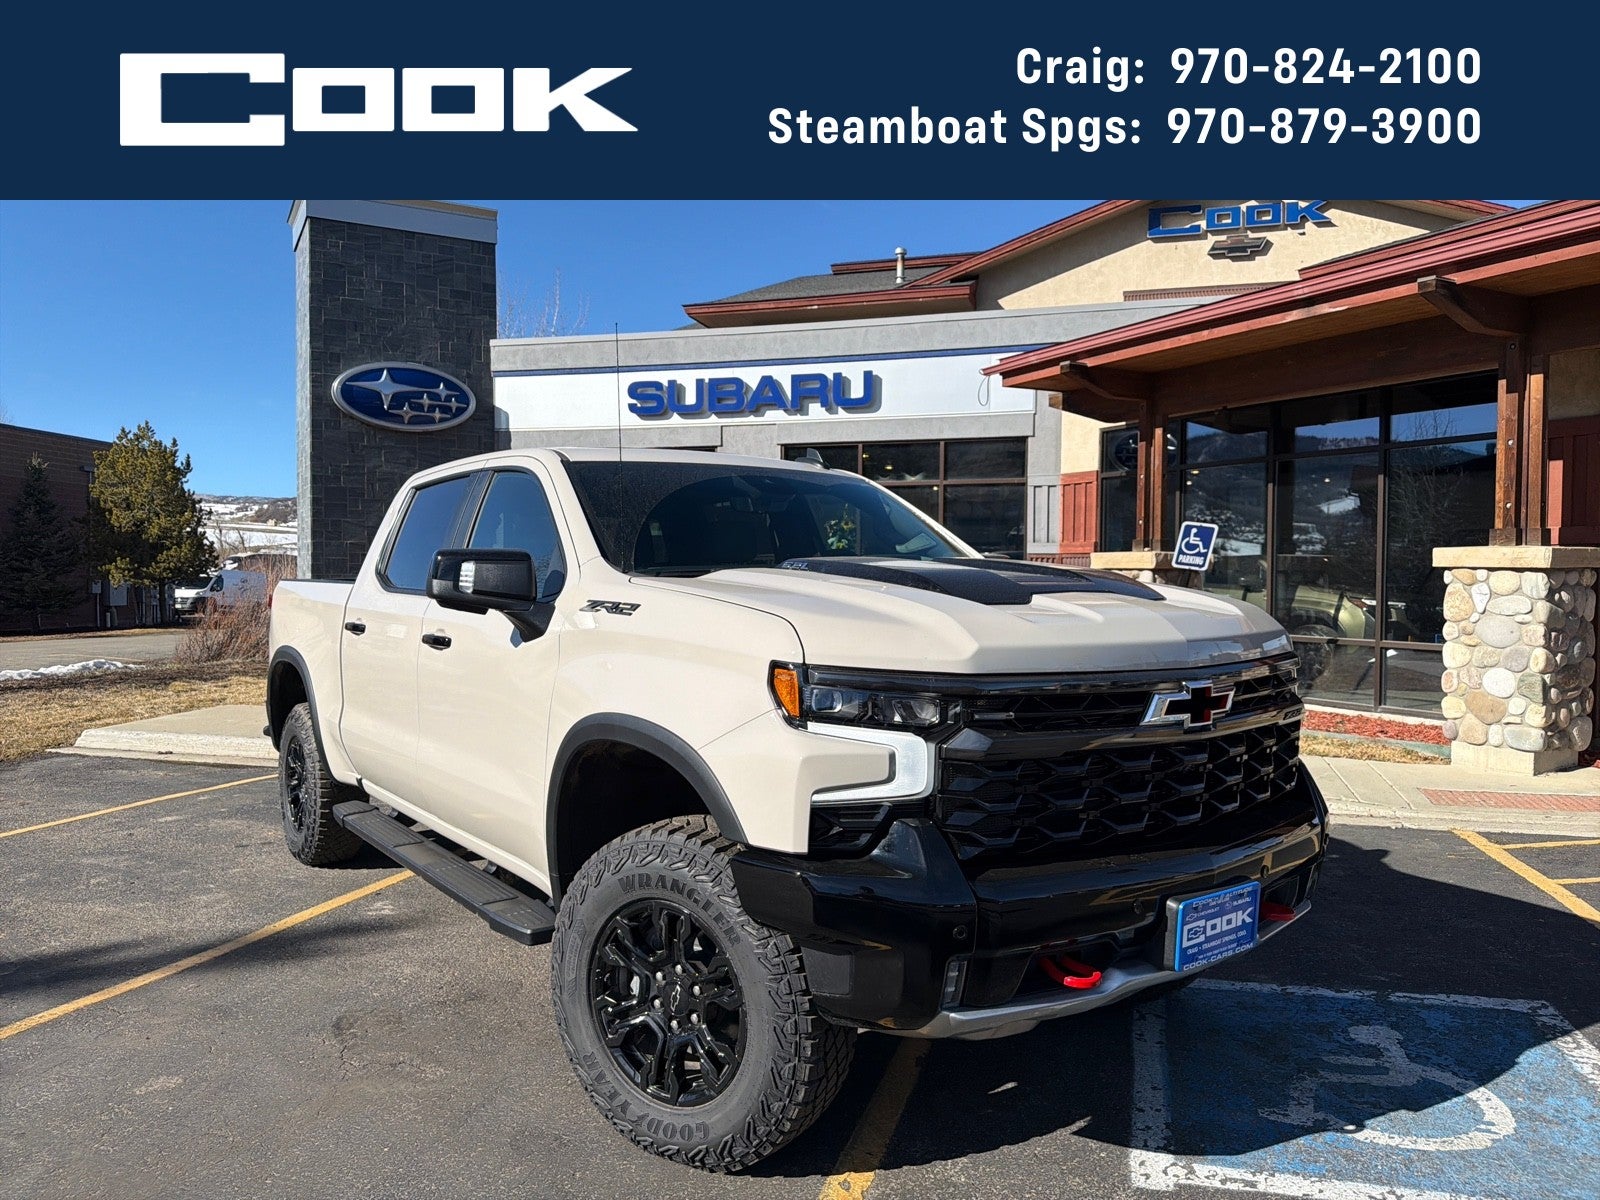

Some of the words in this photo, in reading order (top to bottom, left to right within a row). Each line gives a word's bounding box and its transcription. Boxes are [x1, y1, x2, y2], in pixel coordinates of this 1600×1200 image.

[628, 370, 876, 415] SUBARU
[1178, 554, 1204, 565] PARKING
[579, 599, 642, 617] ZR2
[618, 872, 741, 947] WRANGLER
[1232, 897, 1251, 906] SUBARU
[1183, 943, 1254, 971] COOK-CARS.COM
